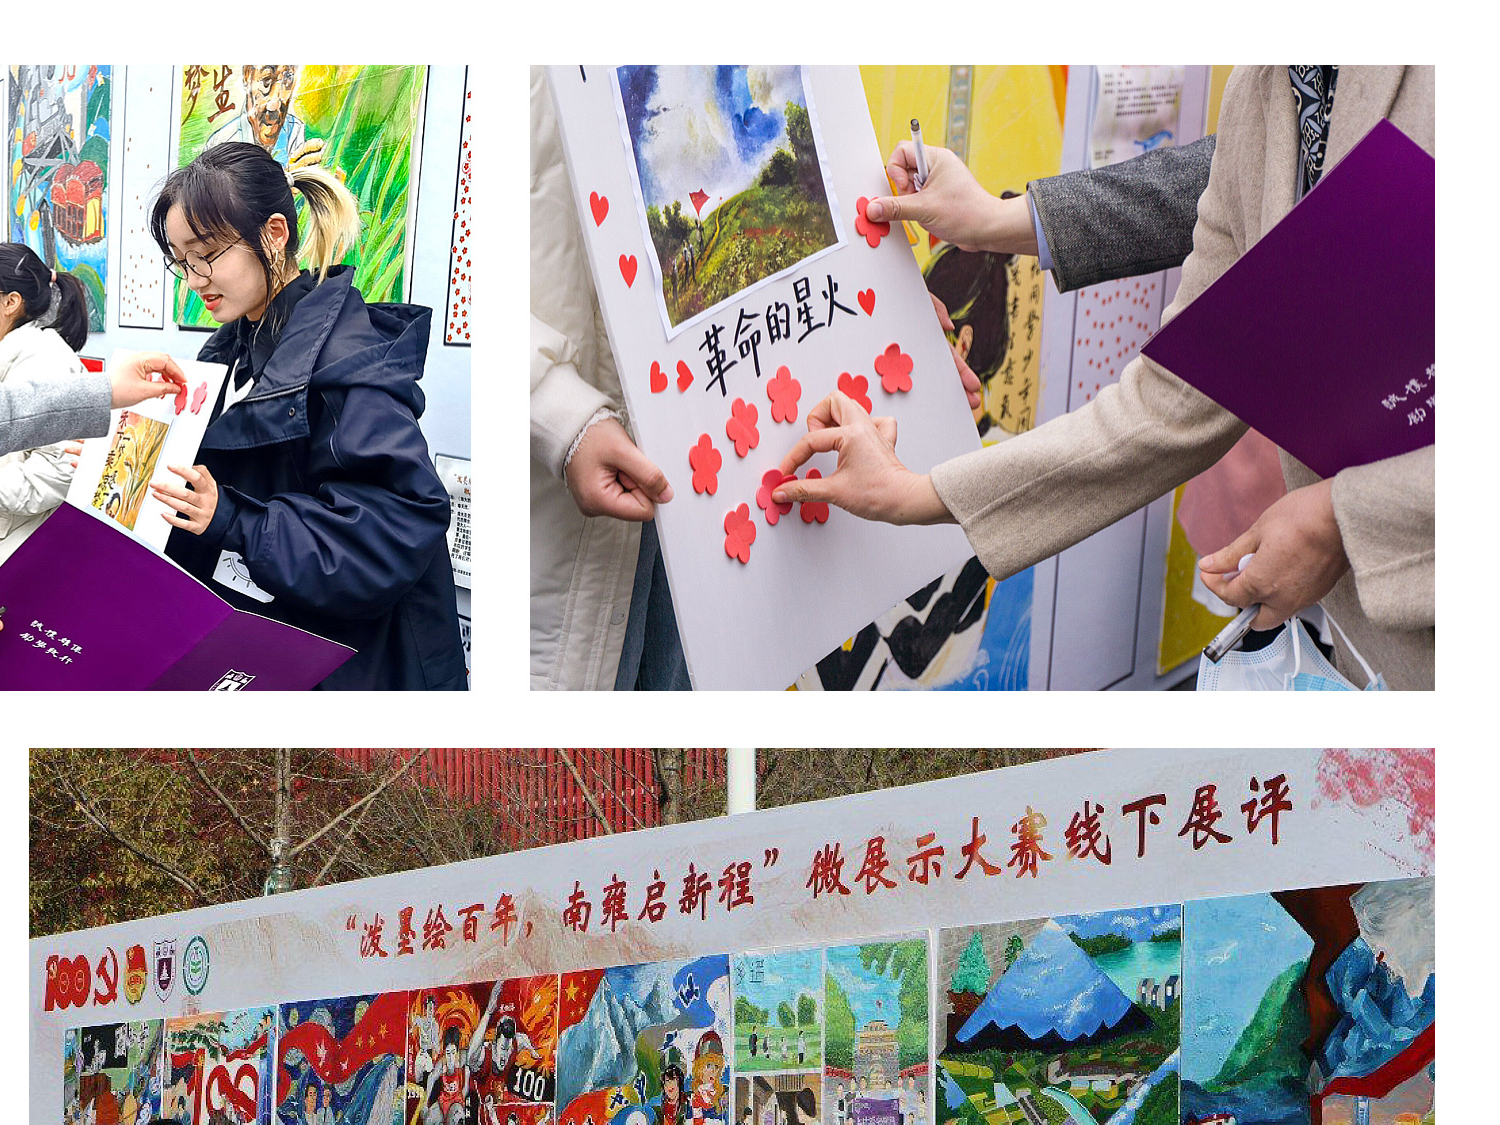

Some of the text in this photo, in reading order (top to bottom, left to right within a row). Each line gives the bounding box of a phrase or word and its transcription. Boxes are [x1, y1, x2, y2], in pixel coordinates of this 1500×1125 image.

[699, 274, 858, 398] 革命的星火
[513, 1069, 547, 1101] 100
